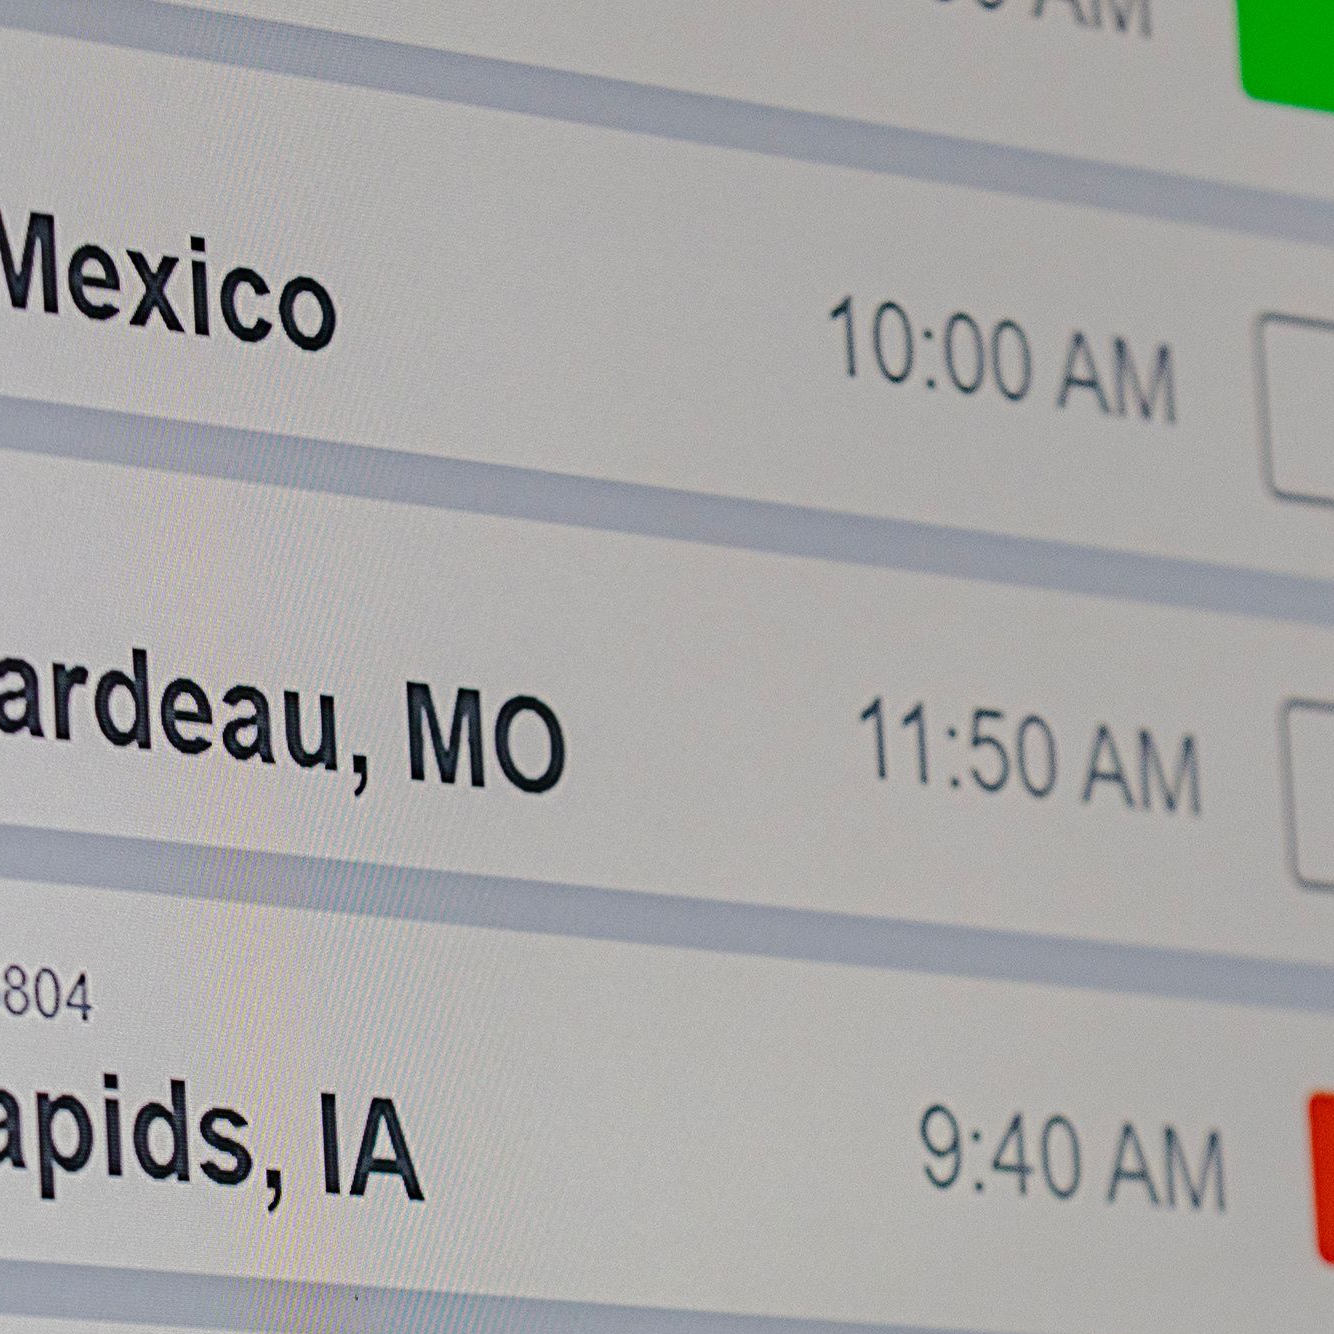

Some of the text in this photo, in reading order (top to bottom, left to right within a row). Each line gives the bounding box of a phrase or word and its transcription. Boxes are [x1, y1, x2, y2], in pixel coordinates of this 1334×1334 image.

[828, 295, 1176, 422] 10:00 AM
[405, 680, 566, 795] MO
[858, 696, 1201, 814] 11:50 AM
[320, 1091, 425, 1202] IA
[918, 1102, 1226, 1211] 9:40 AM
